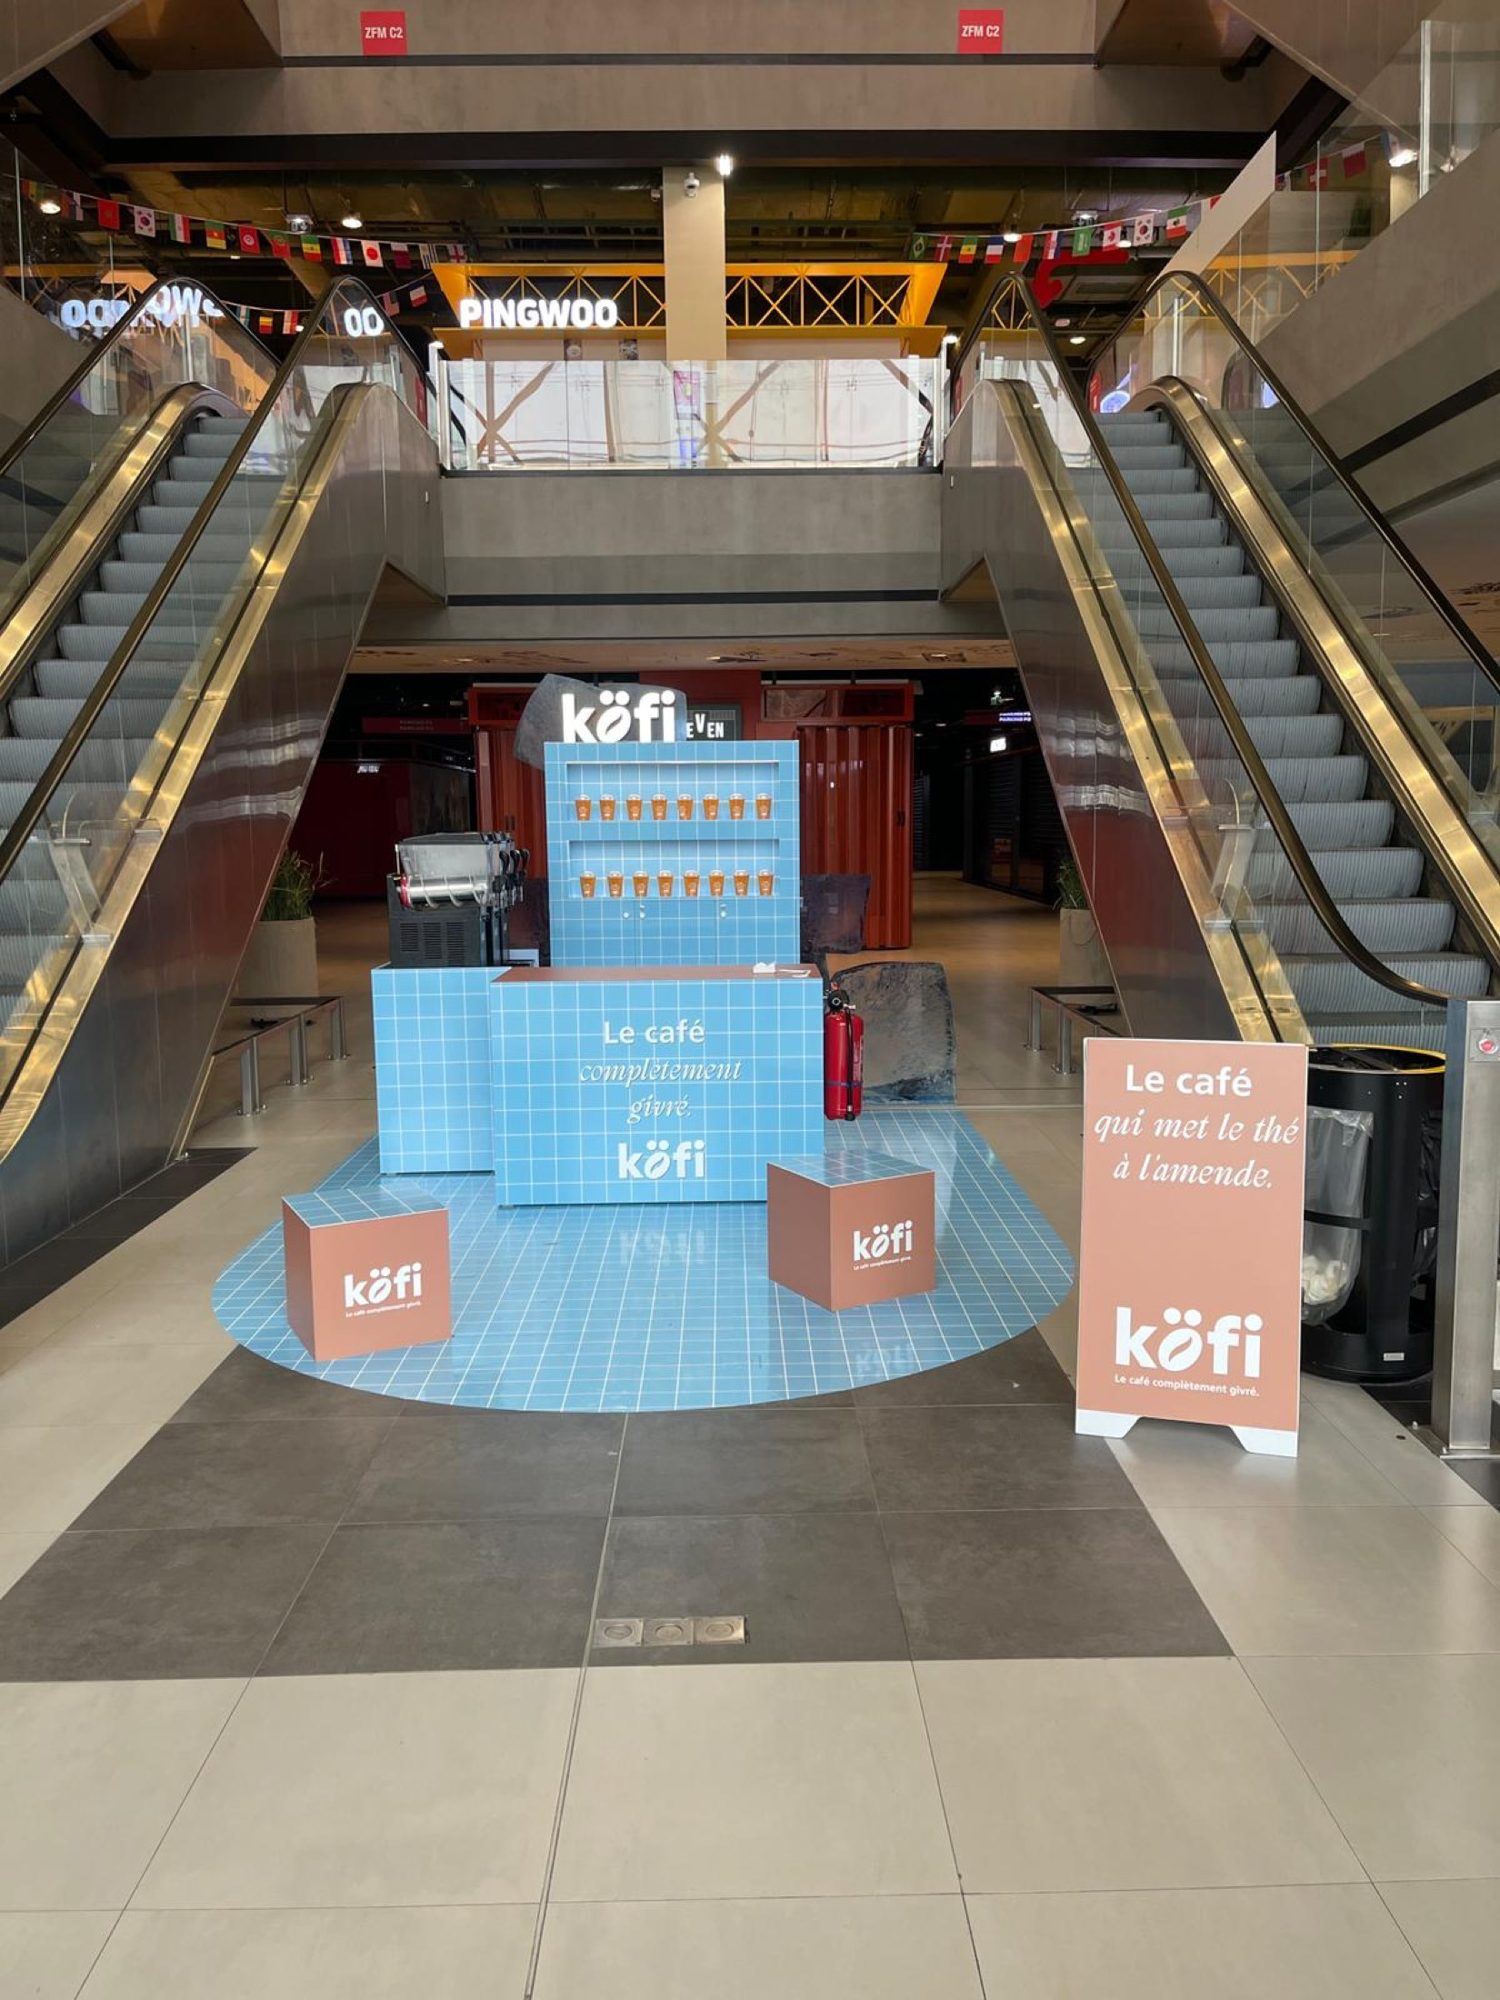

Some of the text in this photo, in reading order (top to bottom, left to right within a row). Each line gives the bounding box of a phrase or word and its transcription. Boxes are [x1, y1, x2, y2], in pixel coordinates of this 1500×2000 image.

[363, 26, 404, 39] ZFM C2
[961, 25, 1000, 38] ZFM C2
[459, 298, 618, 329] PINGWOO
[561, 689, 675, 743] köfi
[604, 1019, 704, 1044] Le café
[580, 1057, 743, 1088] complètement
[1126, 1064, 1252, 1097] Le café
[1094, 1109, 1300, 1144] qui met le thé
[617, 1139, 706, 1180] köfi
[1113, 1153, 1273, 1189] à l'amende.
[853, 1219, 913, 1261] köfi
[344, 1262, 422, 1308] köfi
[1115, 1306, 1263, 1378] köfi
[1115, 1373, 1127, 1384] Le
[1129, 1375, 1150, 1386] café
[1152, 1378, 1227, 1394] complètement
